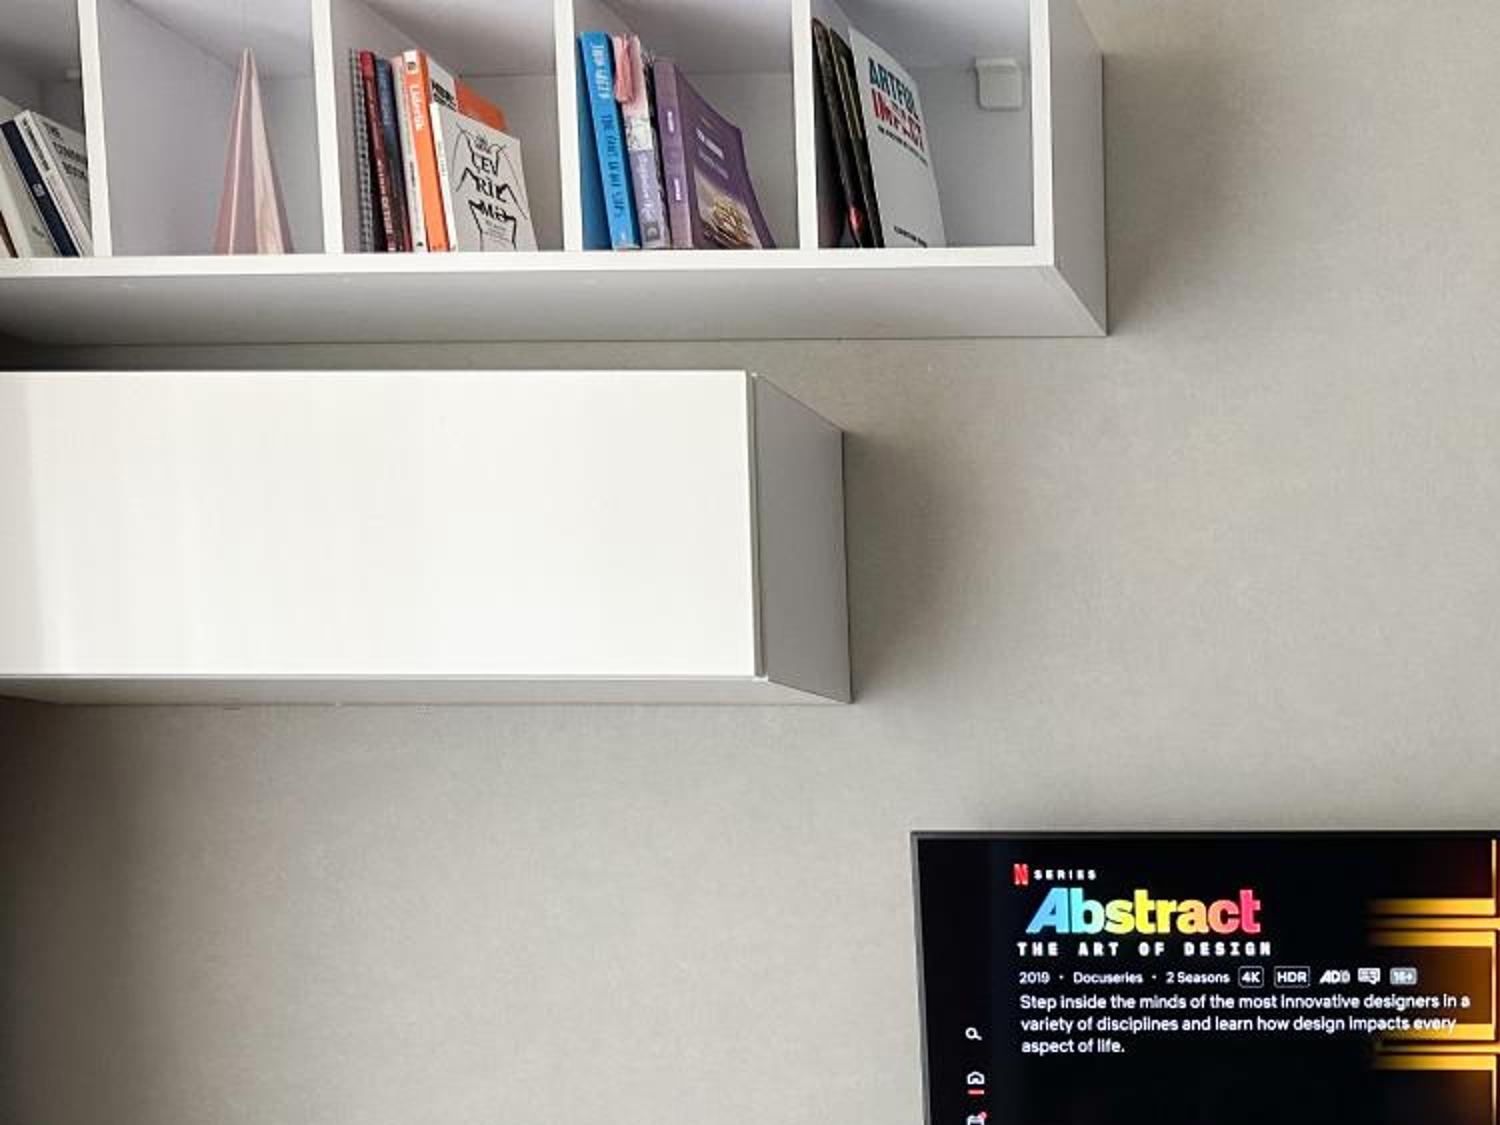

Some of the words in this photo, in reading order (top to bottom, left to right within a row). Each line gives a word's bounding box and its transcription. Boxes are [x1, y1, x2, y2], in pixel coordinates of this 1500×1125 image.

[1034, 869, 1097, 881] SERIES
[1024, 888, 1261, 934] Abstract
[1017, 941, 1058, 957] THE
[1078, 941, 1119, 957] ART
[1139, 941, 1165, 957] OF
[1184, 941, 1271, 957] DESIGN
[1019, 971, 1051, 984] 2019
[1073, 971, 1143, 984] Docuseries
[1178, 972, 1230, 984] Seasons
[1242, 971, 1261, 984] 4K
[1277, 971, 1307, 984] HDR
[1020, 994, 1056, 1012] Step
[1061, 994, 1106, 1009] inside
[1110, 994, 1136, 1009] the
[1140, 994, 1186, 1009] minds
[1190, 994, 1206, 1009] of
[1210, 994, 1234, 1009] the
[1239, 994, 1277, 1009] most
[1281, 994, 1360, 1009] innovative
[1364, 994, 1440, 1011] designers
[1444, 993, 1457, 1008] in
[1461, 996, 1471, 1008] a
[1021, 1016, 1073, 1034] variety
[1077, 1016, 1093, 1031] of
[1097, 1016, 1178, 1034] disciplines
[1182, 1016, 1211, 1031] and
[1215, 1016, 1253, 1031] learn
[1257, 1016, 1290, 1031] how
[1293, 1016, 1345, 1034] design
[1349, 1016, 1410, 1033] impacts
[1413, 1018, 1457, 1033] every
[1022, 1039, 1074, 1056] aspect
[1078, 1038, 1093, 1053] of
[1098, 1038, 1125, 1053] life.
